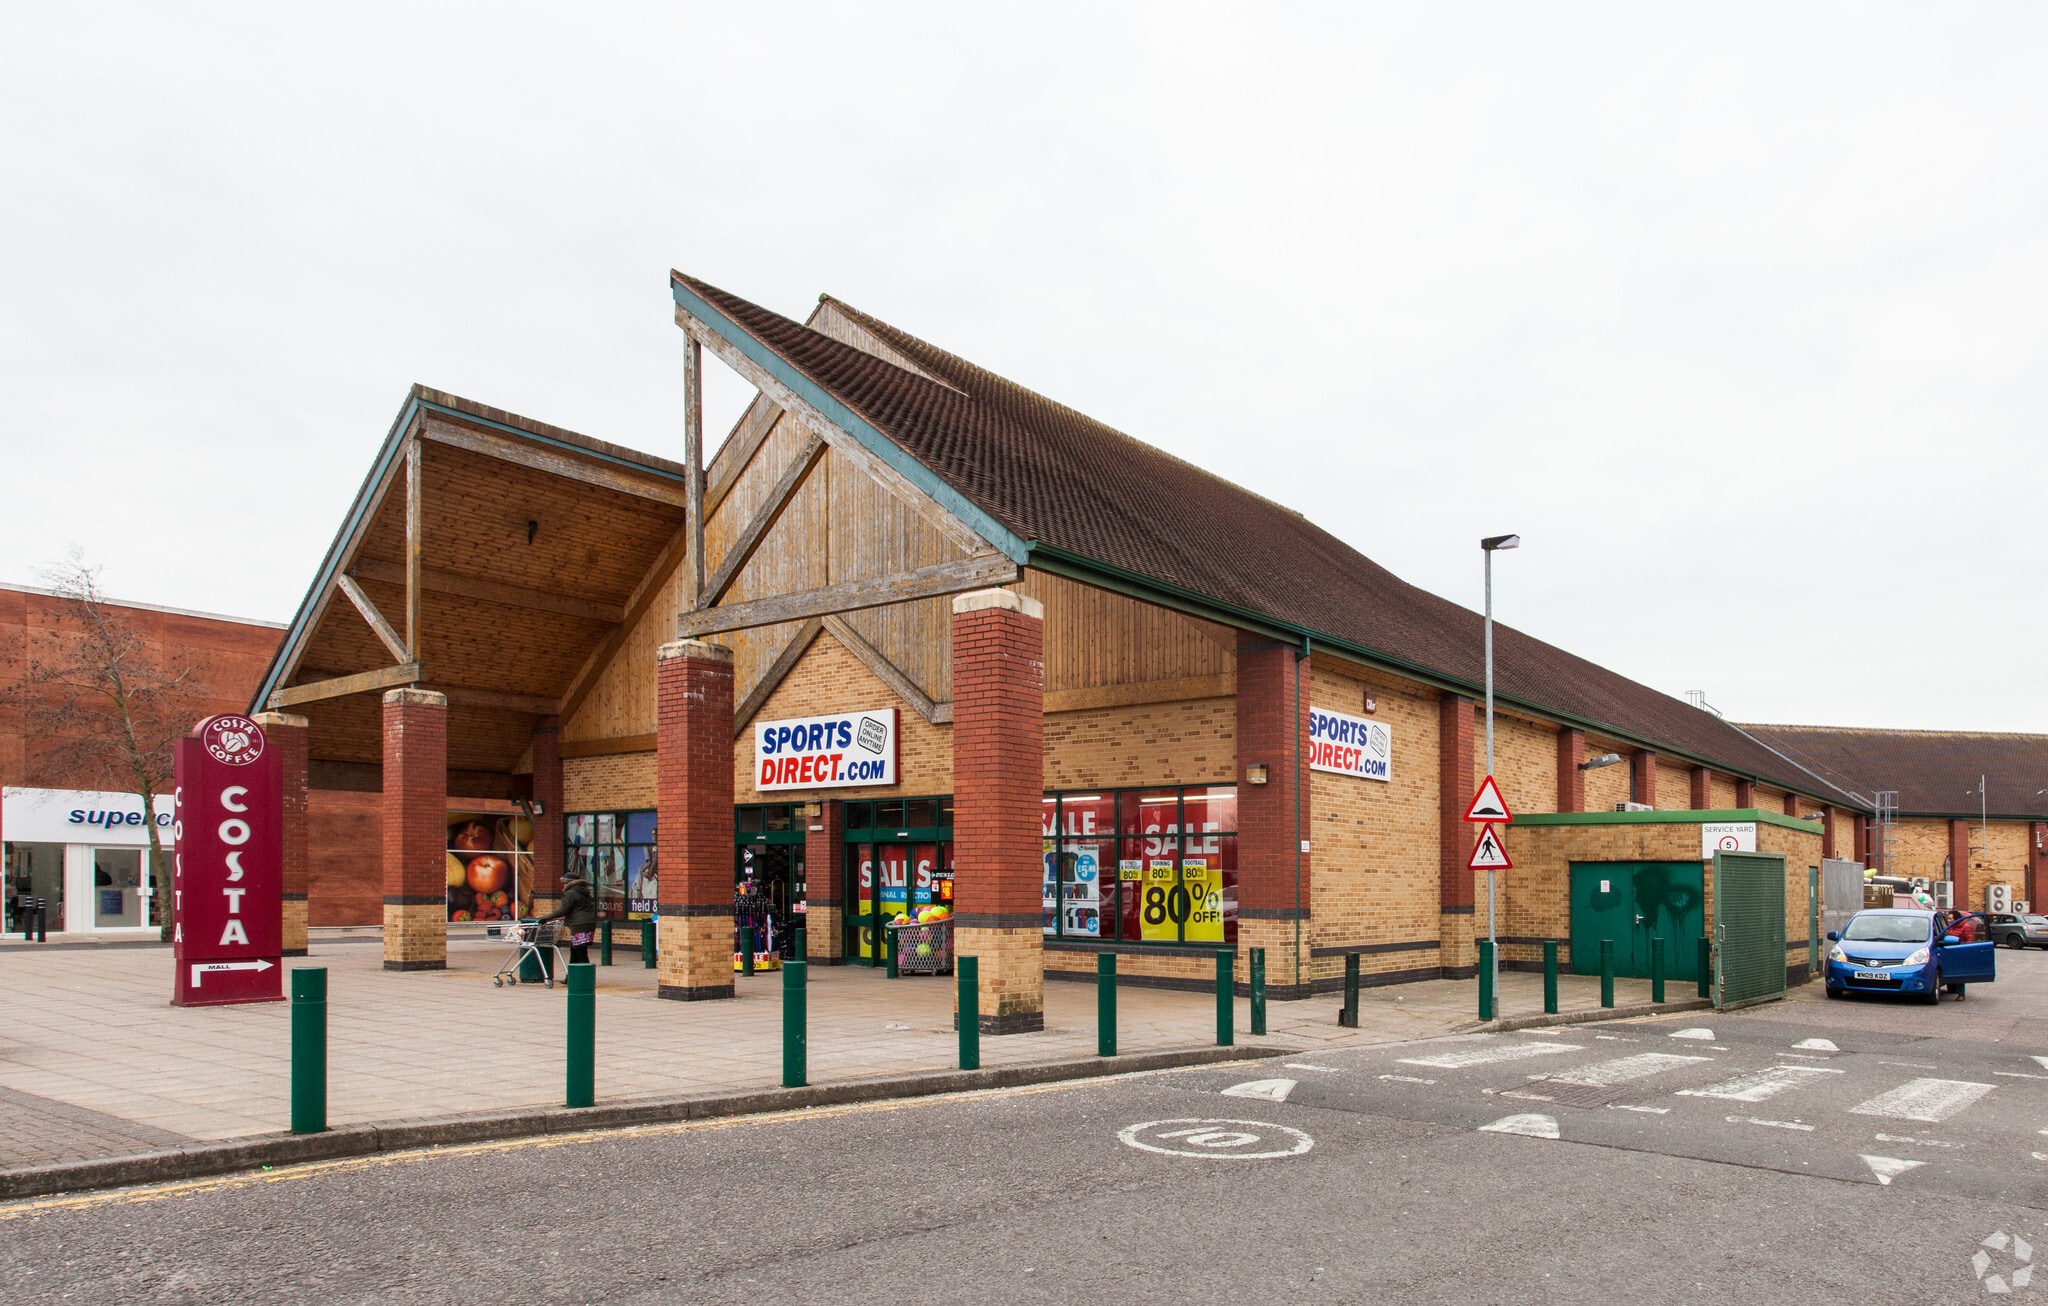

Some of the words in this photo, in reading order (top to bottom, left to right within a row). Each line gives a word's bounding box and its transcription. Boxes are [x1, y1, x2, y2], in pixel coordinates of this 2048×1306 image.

[213, 719, 254, 734] COSTA
[862, 728, 883, 743] ONLINE
[864, 720, 884, 735] ORDER
[1310, 712, 1368, 747] SPORTS
[762, 720, 853, 754] SPORTS
[859, 736, 883, 752] ANYTIME
[210, 744, 258, 763] COFFEE
[760, 753, 886, 786] DIRECT.COM
[1144, 822, 1219, 856] SALE
[1725, 841, 1732, 849] 5
[174, 786, 182, 943] COSTA
[218, 786, 251, 945] COSTA
[632, 899, 650, 912] field
[1144, 882, 1219, 925] 80%
[1193, 911, 1220, 923] OFF!
